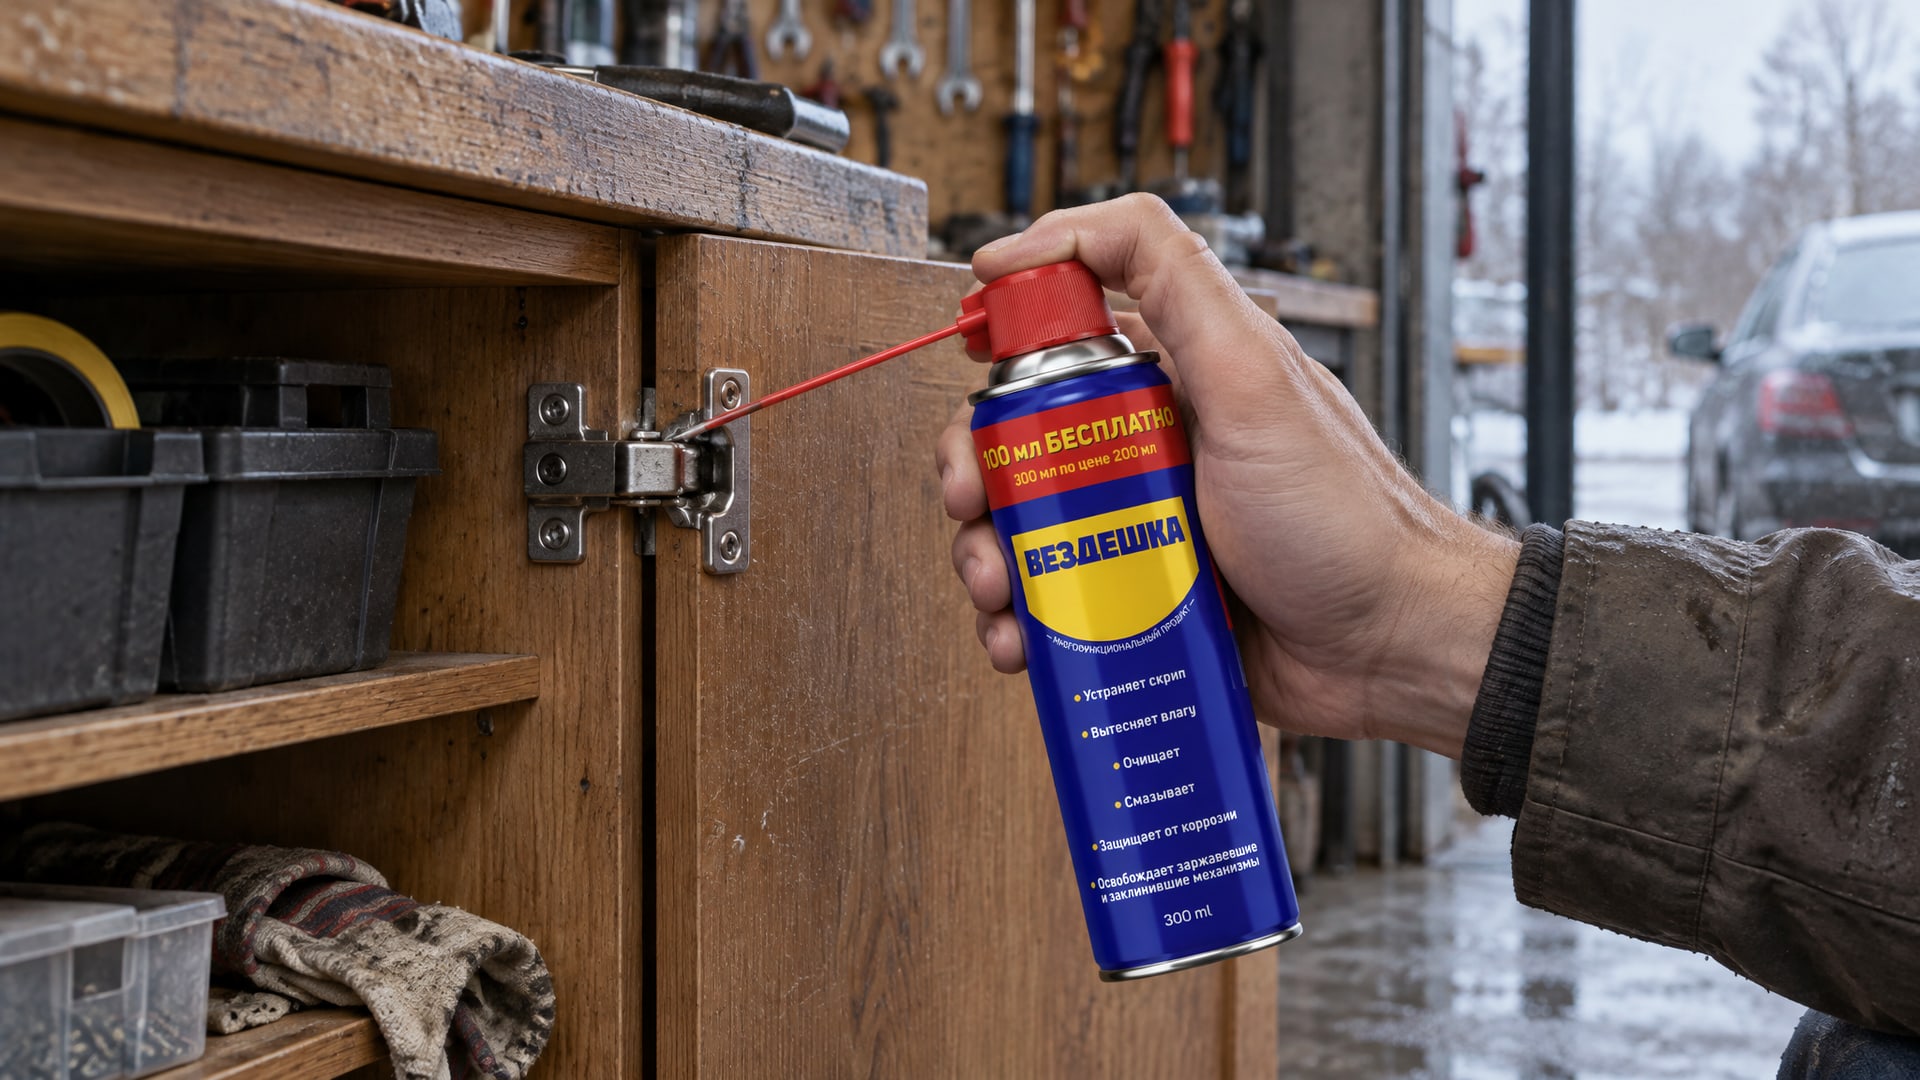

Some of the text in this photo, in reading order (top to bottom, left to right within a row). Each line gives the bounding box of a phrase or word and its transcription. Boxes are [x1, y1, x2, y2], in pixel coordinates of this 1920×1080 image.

[983, 406, 1175, 470] 100 мл БЕСПЛАТНО
[1014, 443, 1157, 487] 300 мл по цене 200 мл
[1024, 516, 1186, 578] ВЕЗДЕШКА
[1083, 669, 1186, 702] Устраняет скрип
[1090, 705, 1197, 739] Вытесняет влагу
[1122, 747, 1181, 769] Очищает
[1124, 783, 1195, 808] Смазывает
[1099, 810, 1238, 851] Защищает от коррозии
[1097, 842, 1258, 890] Освобождает заржавевшие
[1101, 857, 1260, 904] и заклинившие механизмы
[1163, 904, 1213, 927] 300 ml
